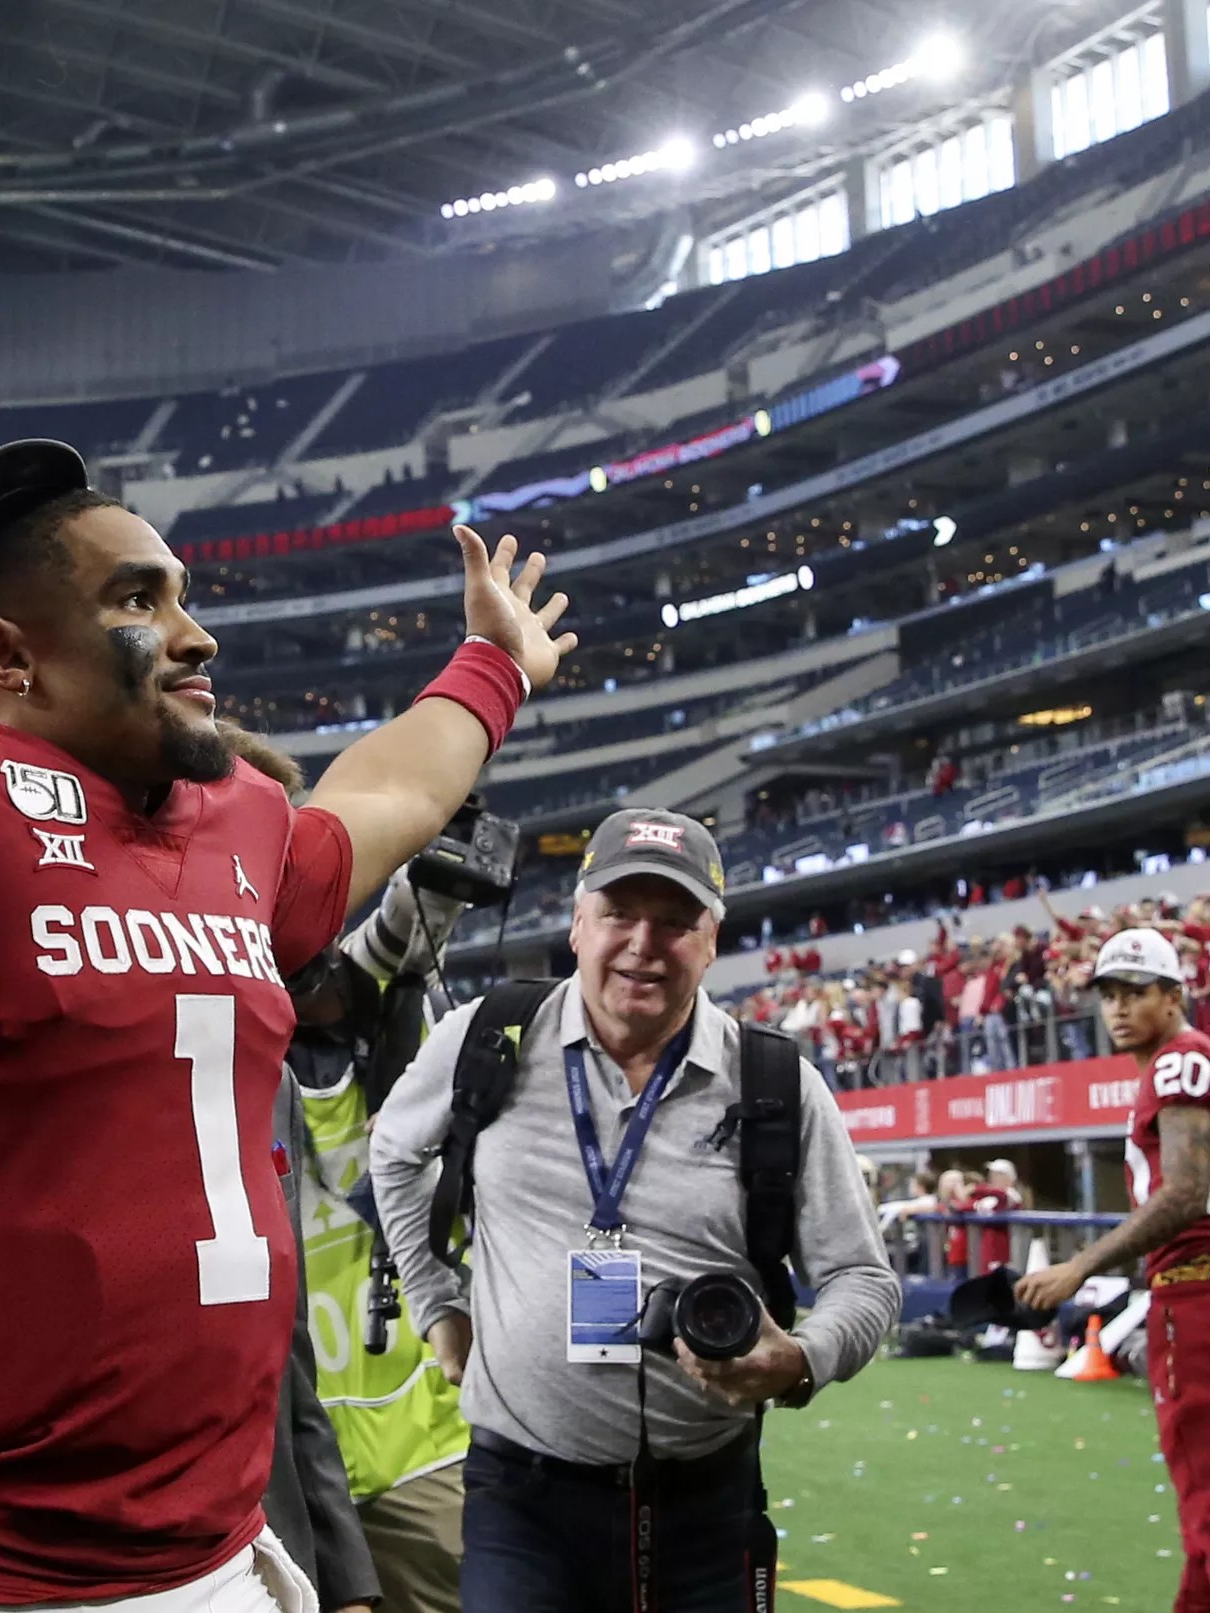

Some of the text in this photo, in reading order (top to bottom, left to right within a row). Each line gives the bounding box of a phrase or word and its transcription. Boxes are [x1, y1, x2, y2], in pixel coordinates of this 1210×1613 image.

[0, 760, 88, 825] 150
[33, 827, 95, 871] XII
[30, 904, 286, 988] SOONERS
[1153, 1051, 1210, 1098] 20
[175, 993, 270, 1305] 1
